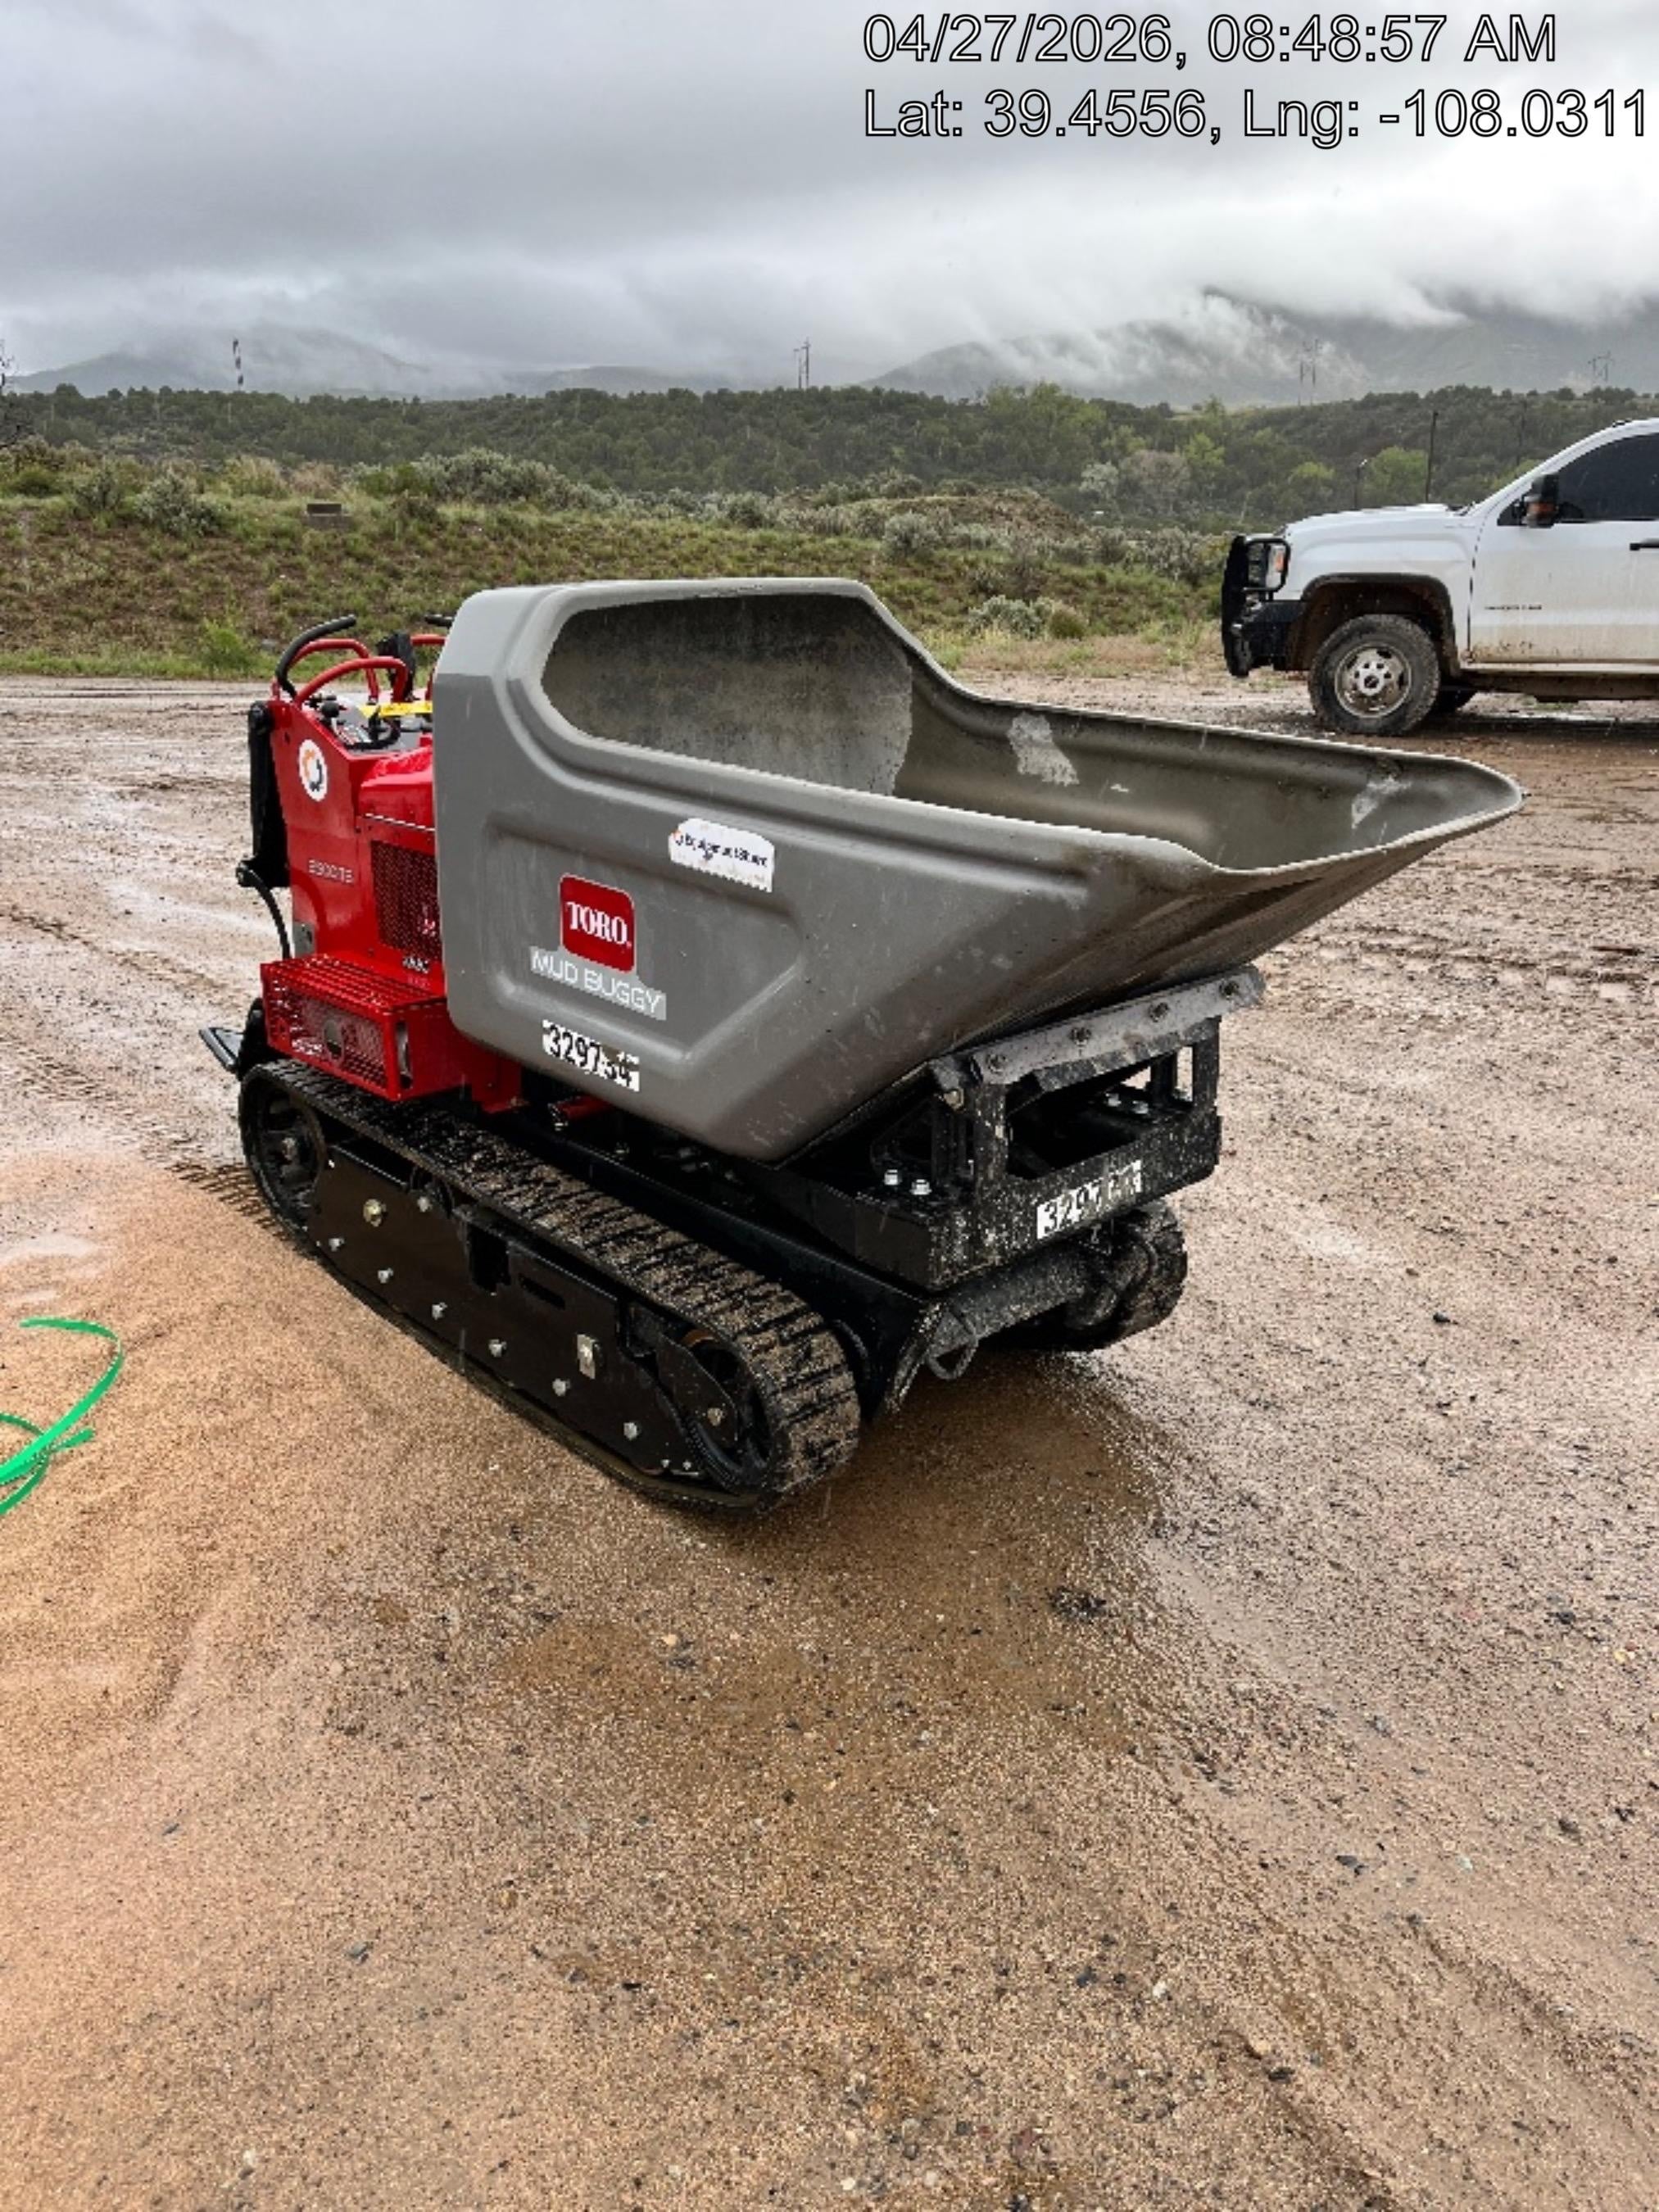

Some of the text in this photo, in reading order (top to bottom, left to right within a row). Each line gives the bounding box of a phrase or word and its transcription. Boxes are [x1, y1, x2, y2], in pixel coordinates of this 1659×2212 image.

[533, 950, 662, 1013] MUD BUGGY
[1043, 1164, 1135, 1234] 3297
